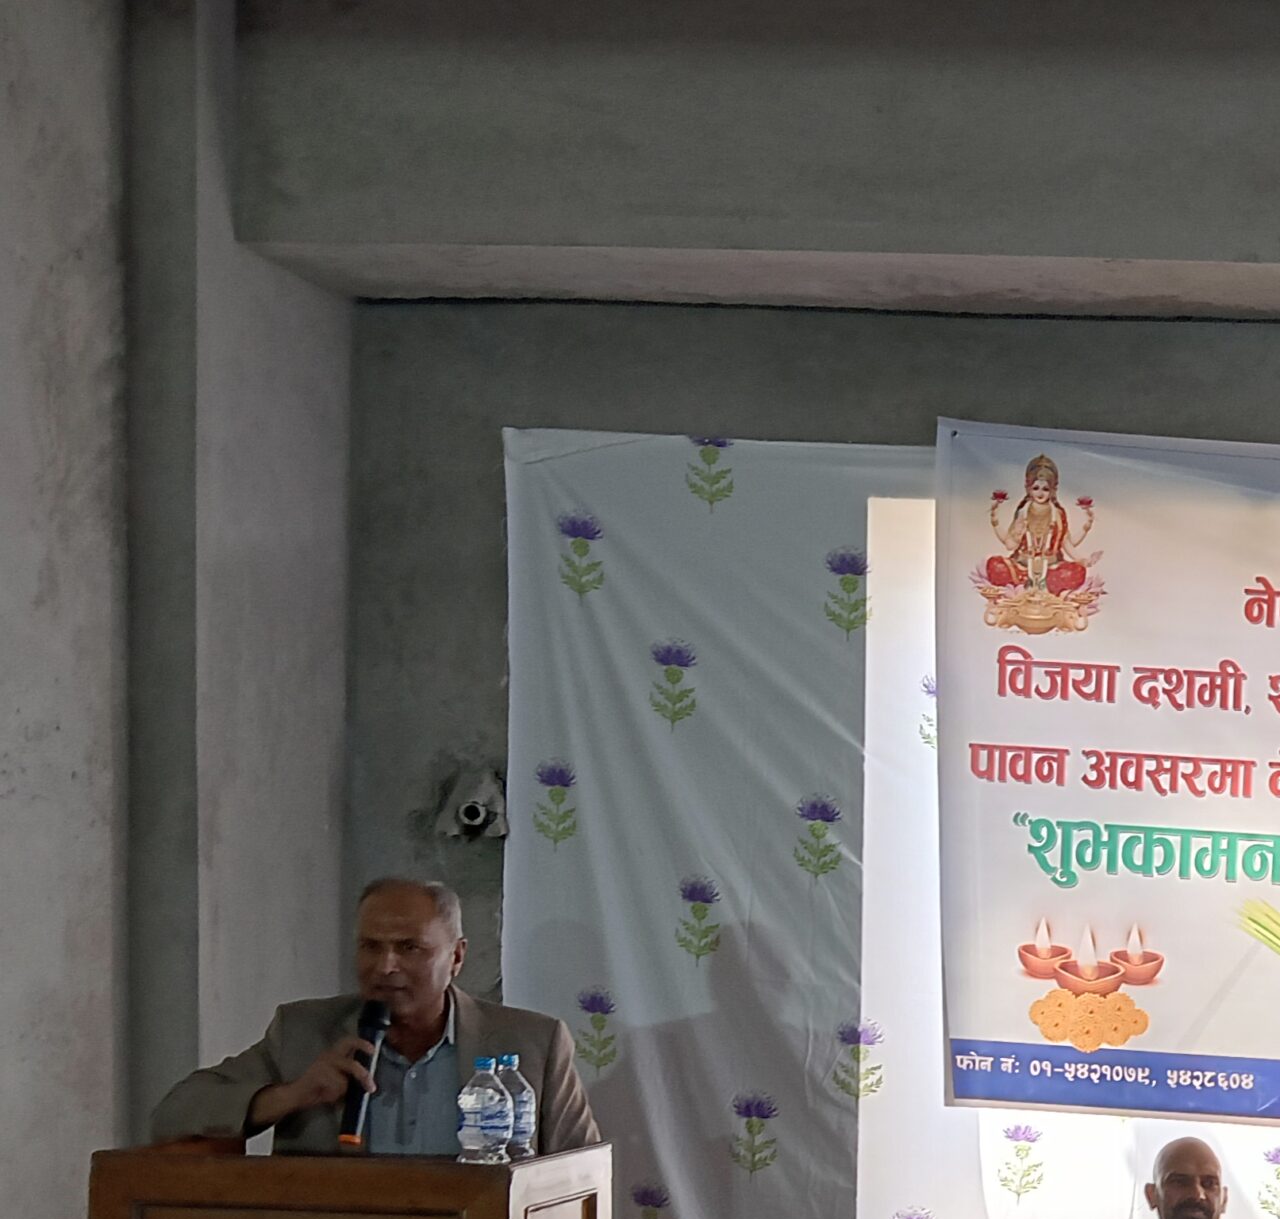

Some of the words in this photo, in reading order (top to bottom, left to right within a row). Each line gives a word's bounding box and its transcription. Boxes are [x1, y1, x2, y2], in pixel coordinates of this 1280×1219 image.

[997, 645, 1121, 704] विजया
[1132, 659, 1252, 716] दशमी,
[968, 741, 1070, 787] पावन
[1081, 749, 1256, 797] अवसरमा
[955, 1051, 993, 1073] फोन
[1166, 1069, 1256, 1090] ५४२८६०४
